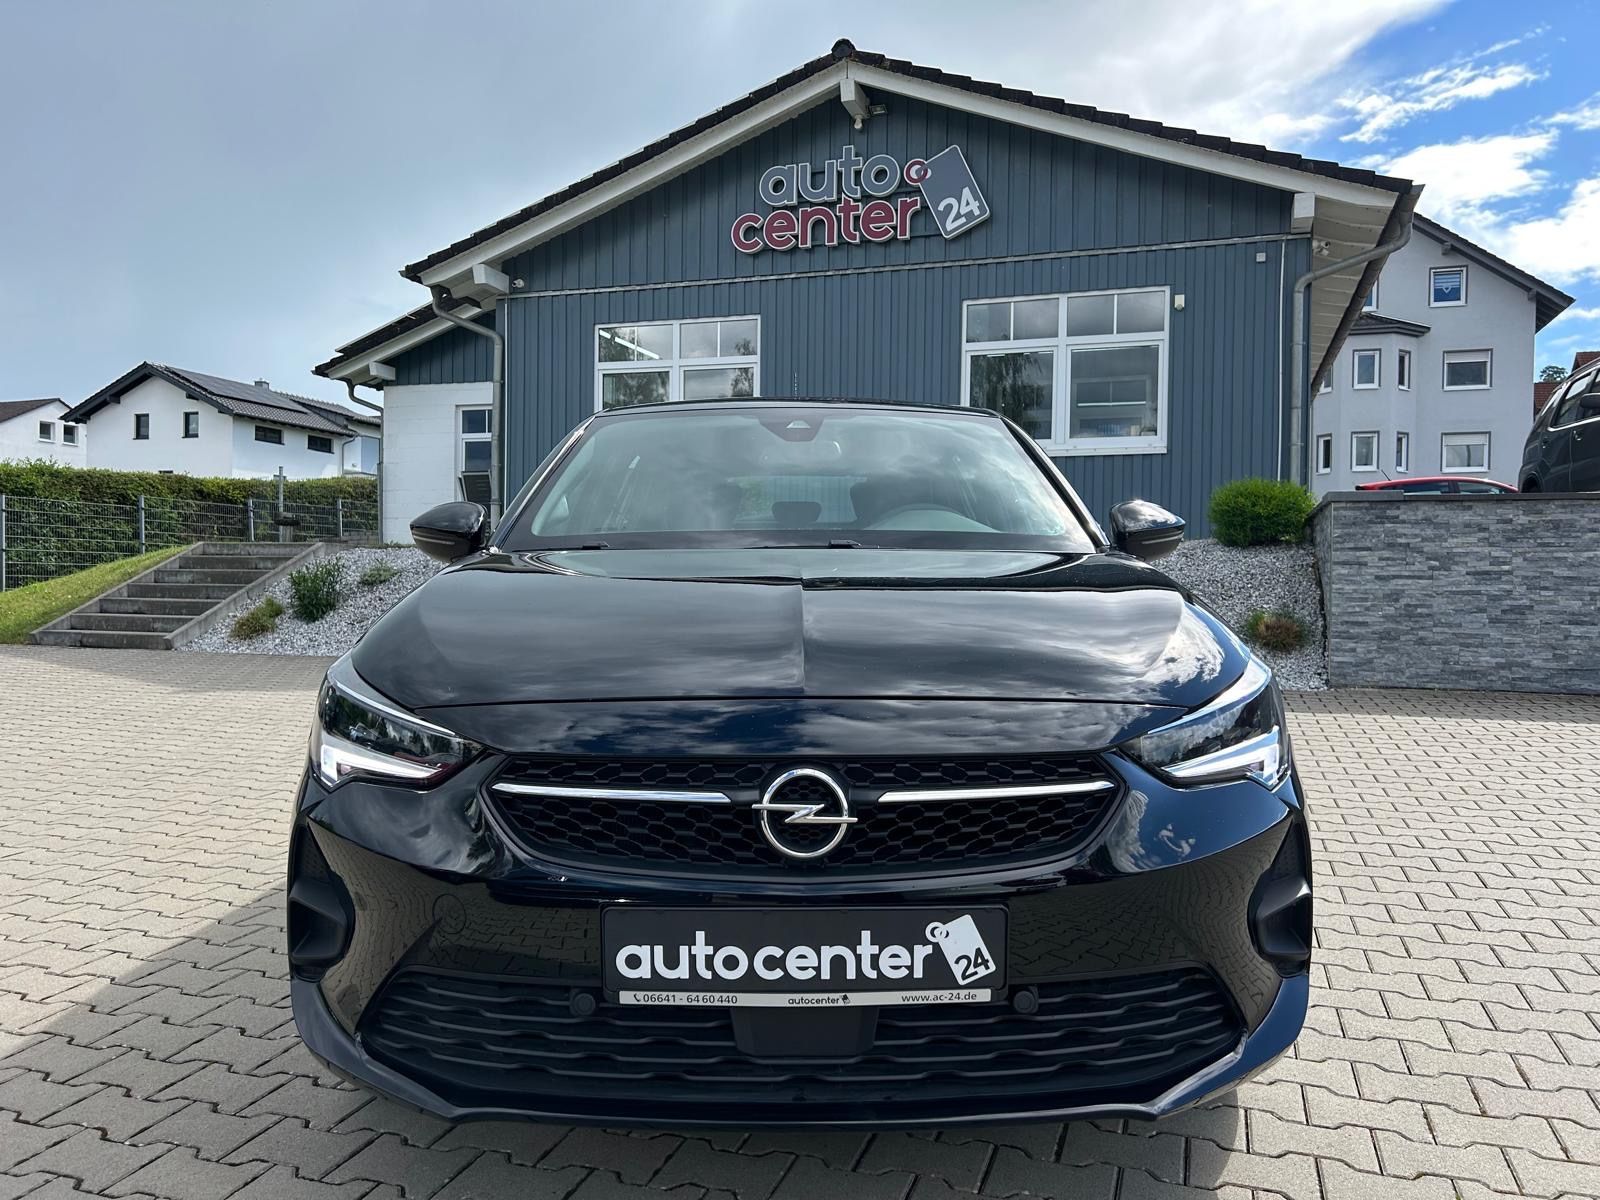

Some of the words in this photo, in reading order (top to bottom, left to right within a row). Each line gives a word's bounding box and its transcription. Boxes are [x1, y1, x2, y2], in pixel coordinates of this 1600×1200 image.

[759, 145, 901, 207] auto
[731, 194, 921, 254] center
[937, 186, 980, 231] 24
[954, 946, 990, 981] 24
[642, 993, 676, 1003] 06641
[787, 996, 840, 1005] autocenter
[901, 991, 977, 1002] www.ac-24.de
